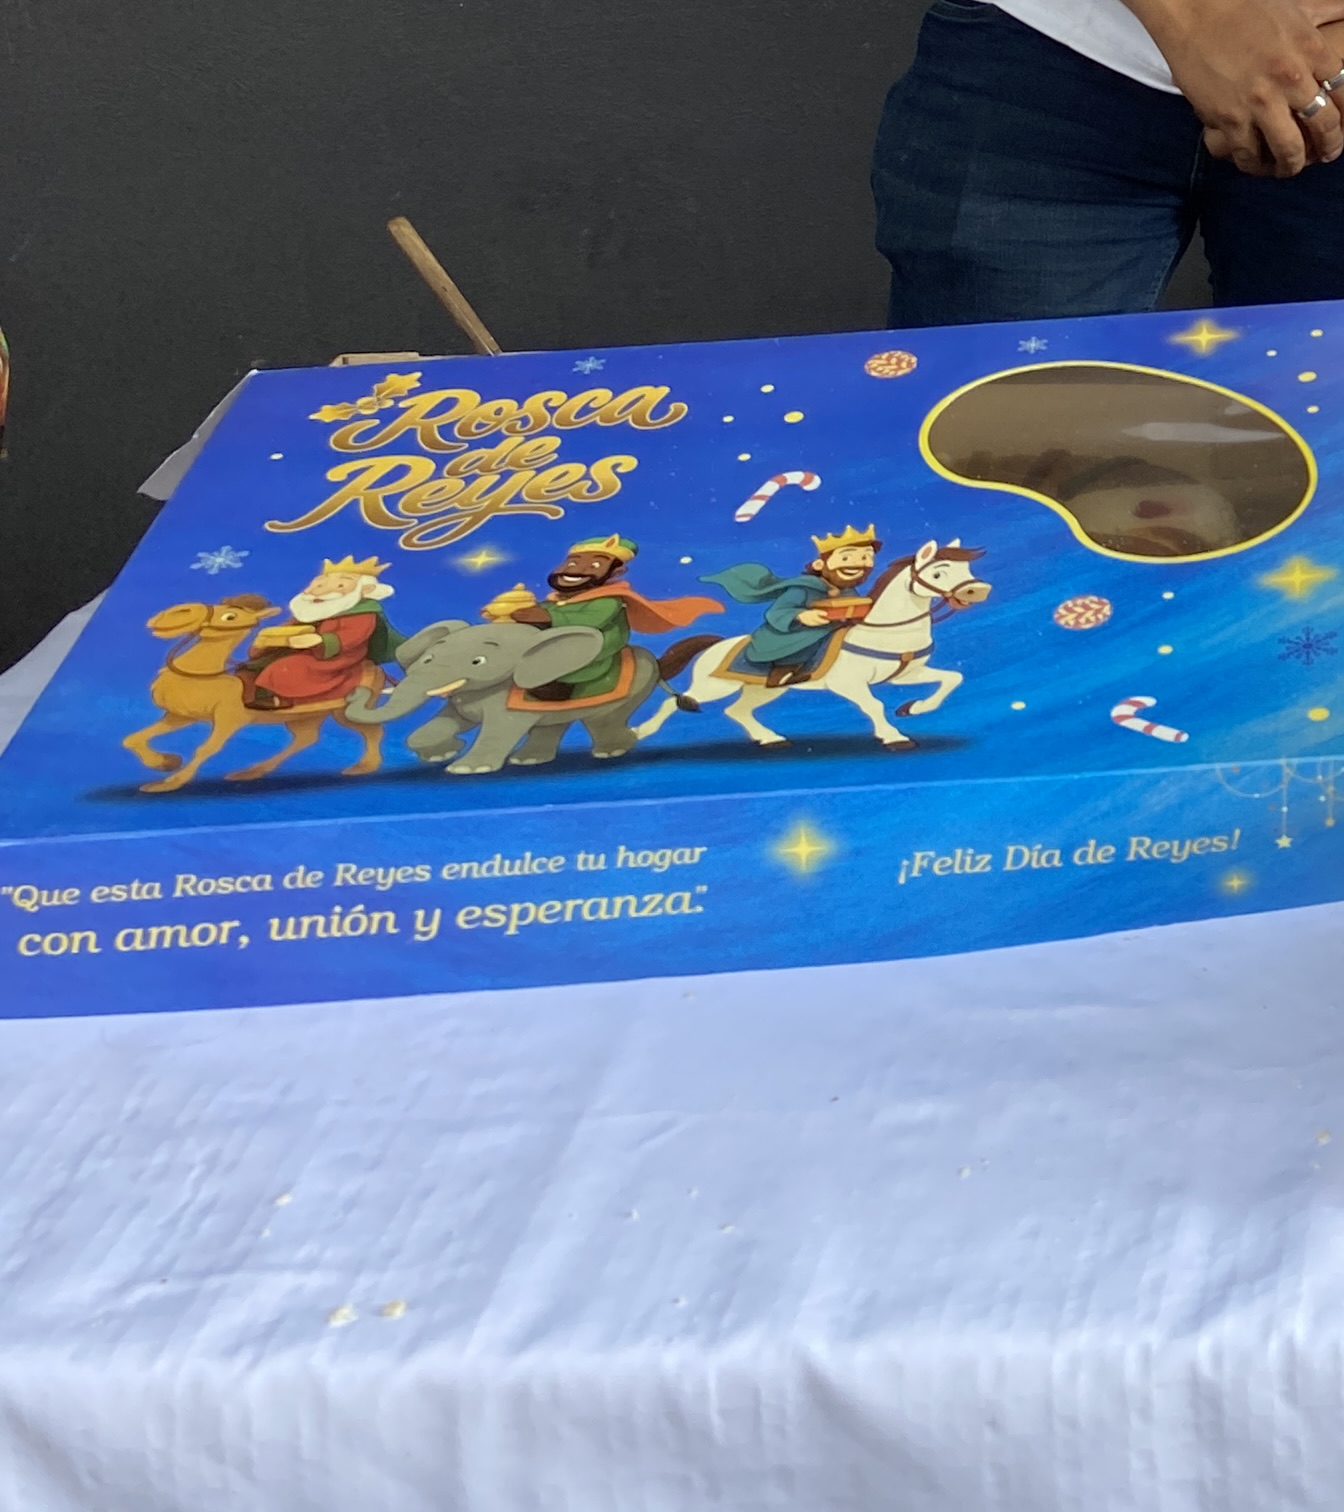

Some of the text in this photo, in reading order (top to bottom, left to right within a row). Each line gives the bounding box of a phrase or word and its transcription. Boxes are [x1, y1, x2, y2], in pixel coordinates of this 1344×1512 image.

[328, 385, 689, 453] Rosca
[444, 435, 562, 478] de
[264, 455, 639, 551] Reyes
[90, 878, 163, 903] esta
[172, 872, 274, 898] Rosca
[282, 865, 325, 889] de
[334, 862, 432, 891] Reyes
[441, 851, 566, 881] endulce
[576, 850, 607, 872] tu
[616, 844, 708, 874] hogar
[898, 828, 1242, 885] ¡Feliz Día de Reyes!
[18, 928, 102, 957] con
[114, 919, 250, 951] amor,
[268, 904, 400, 942] unión
[413, 907, 442, 942] y
